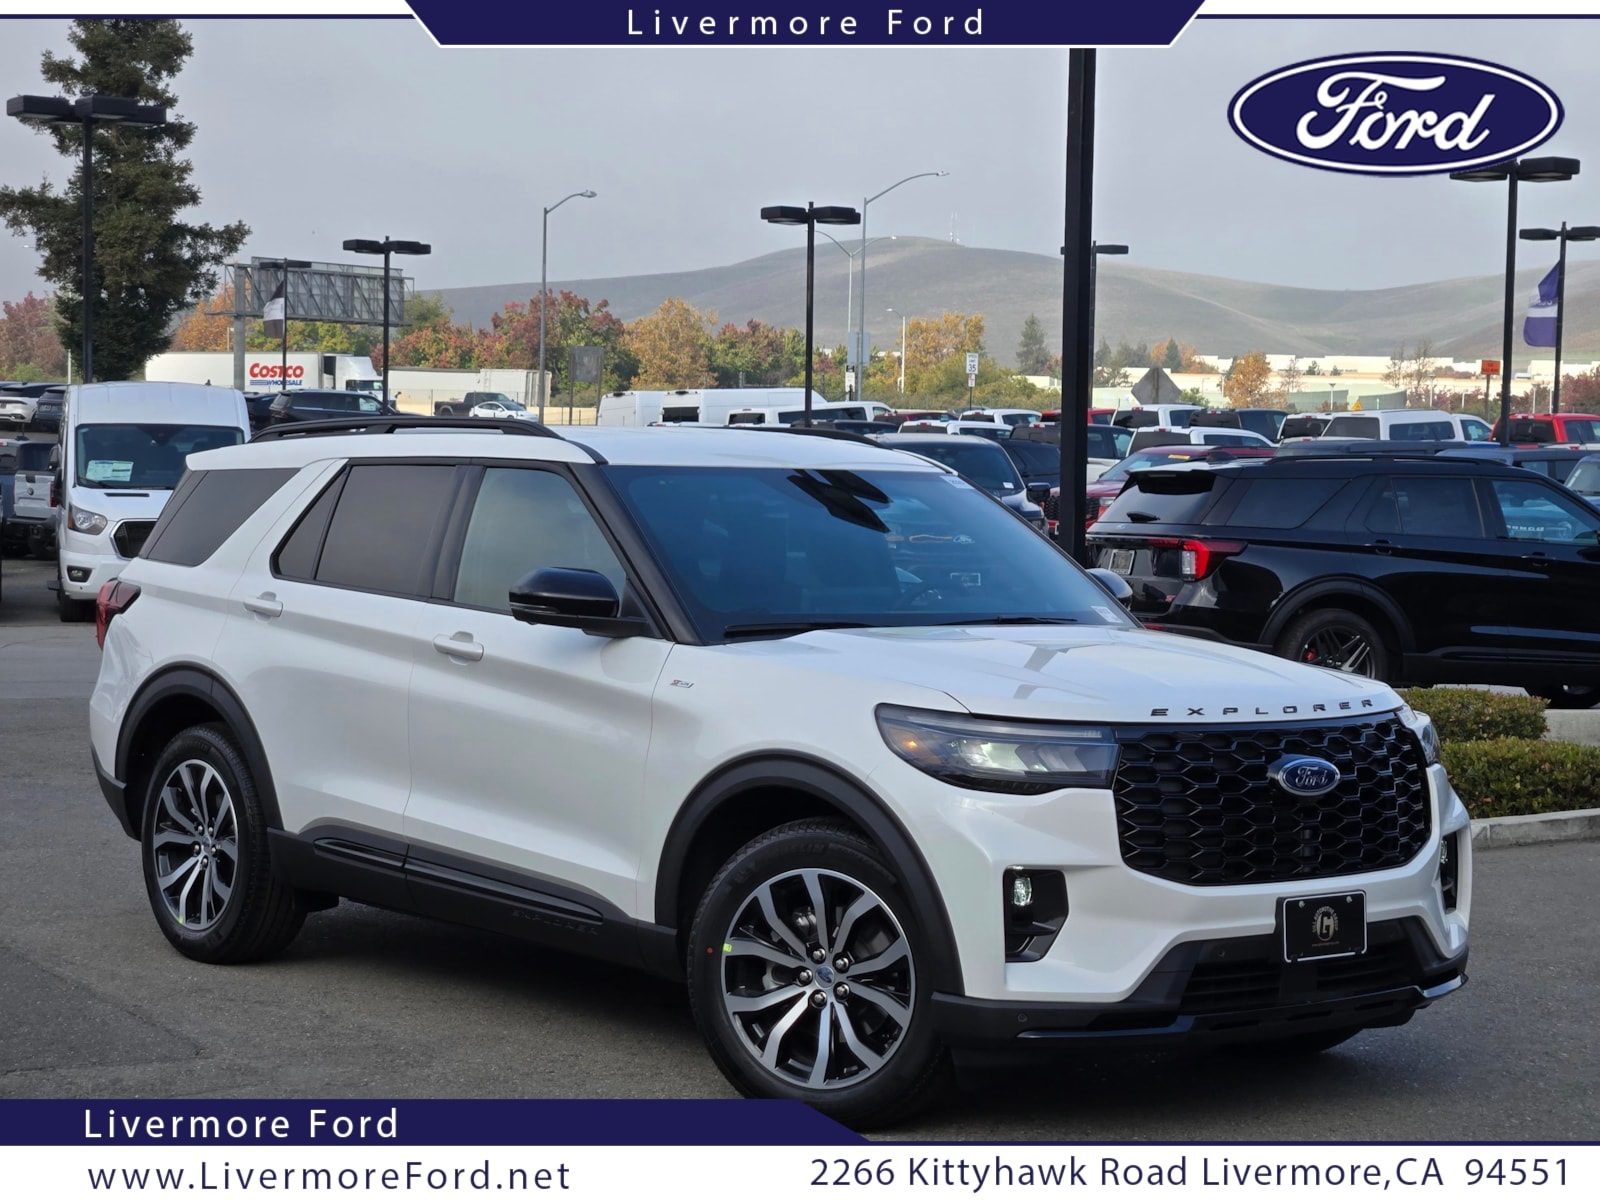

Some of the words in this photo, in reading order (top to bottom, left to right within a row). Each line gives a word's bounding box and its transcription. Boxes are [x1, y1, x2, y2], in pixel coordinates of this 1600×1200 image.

[249, 362, 304, 378] COSTCO
[968, 363, 976, 372] 35
[1150, 699, 1374, 717] EXPLORER
[1295, 766, 1328, 787] Ford
